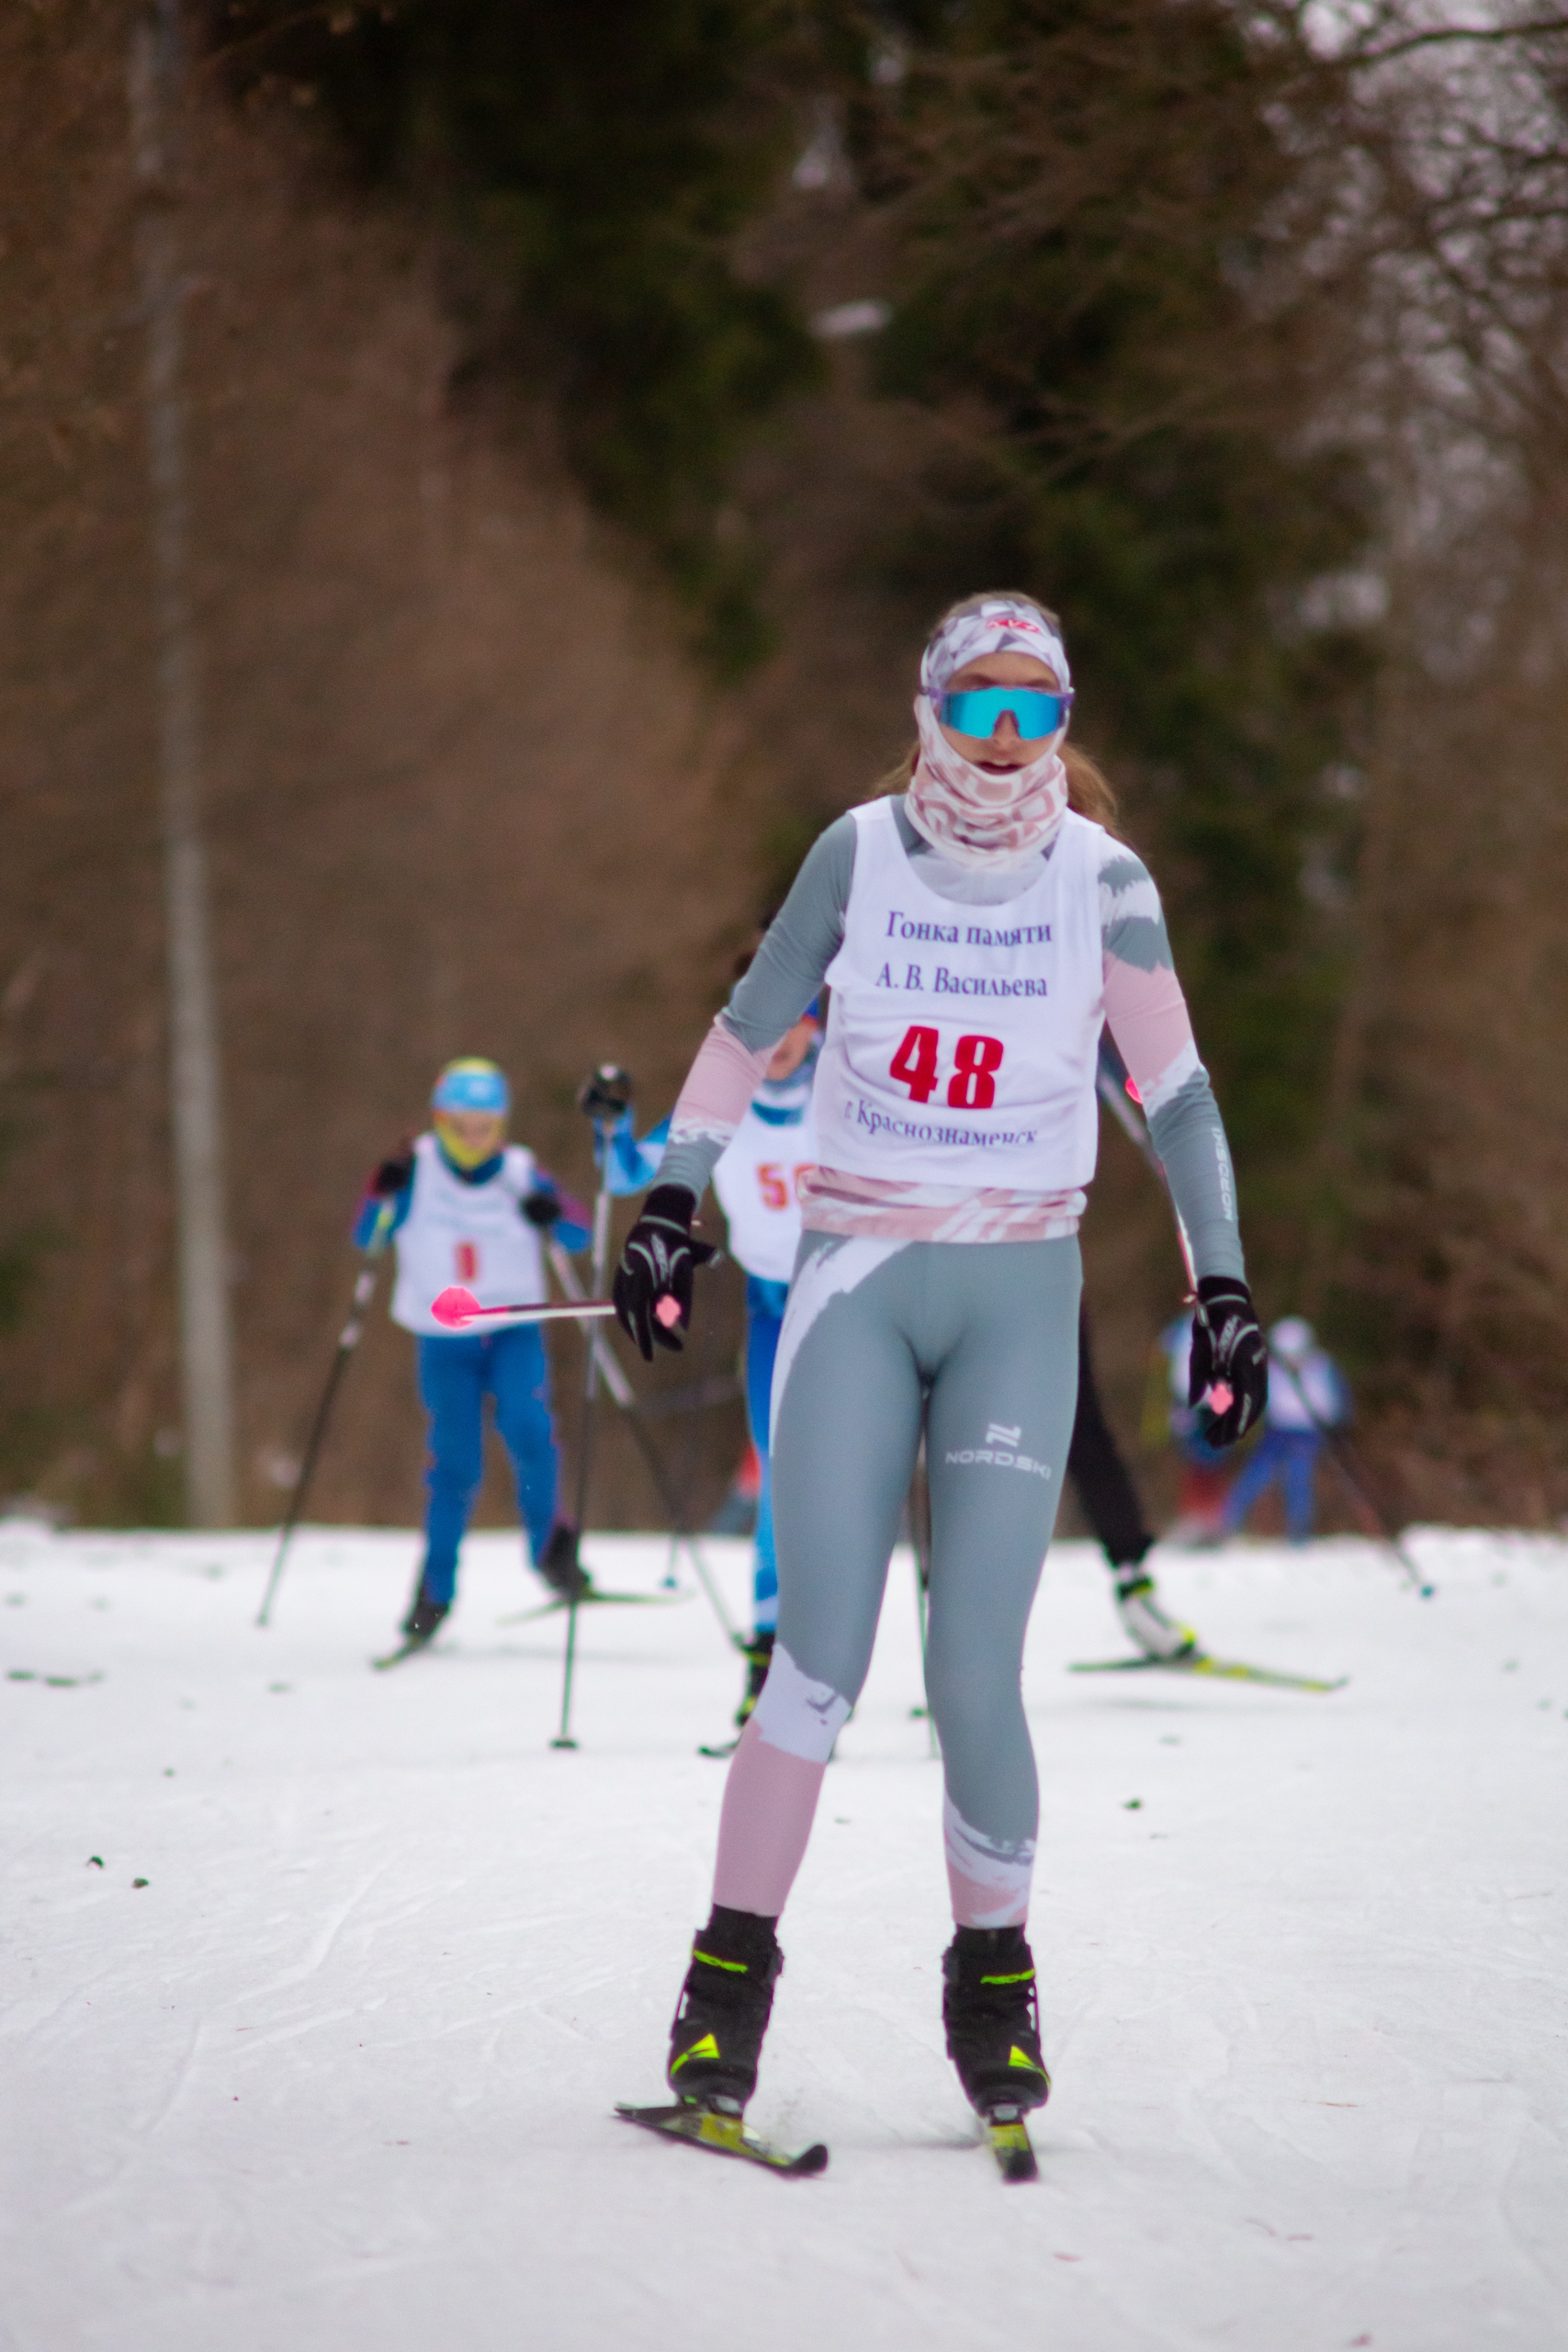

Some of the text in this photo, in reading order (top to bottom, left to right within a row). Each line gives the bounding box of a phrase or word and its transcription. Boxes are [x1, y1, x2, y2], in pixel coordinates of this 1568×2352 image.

[886, 910, 1053, 947] Гонка памяти
[874, 963, 1048, 997] А. В. Васильева
[888, 1024, 1005, 1110] 48
[1211, 1126, 1233, 1222] NORDSKI
[944, 1449, 1052, 1480] NORDSKI
